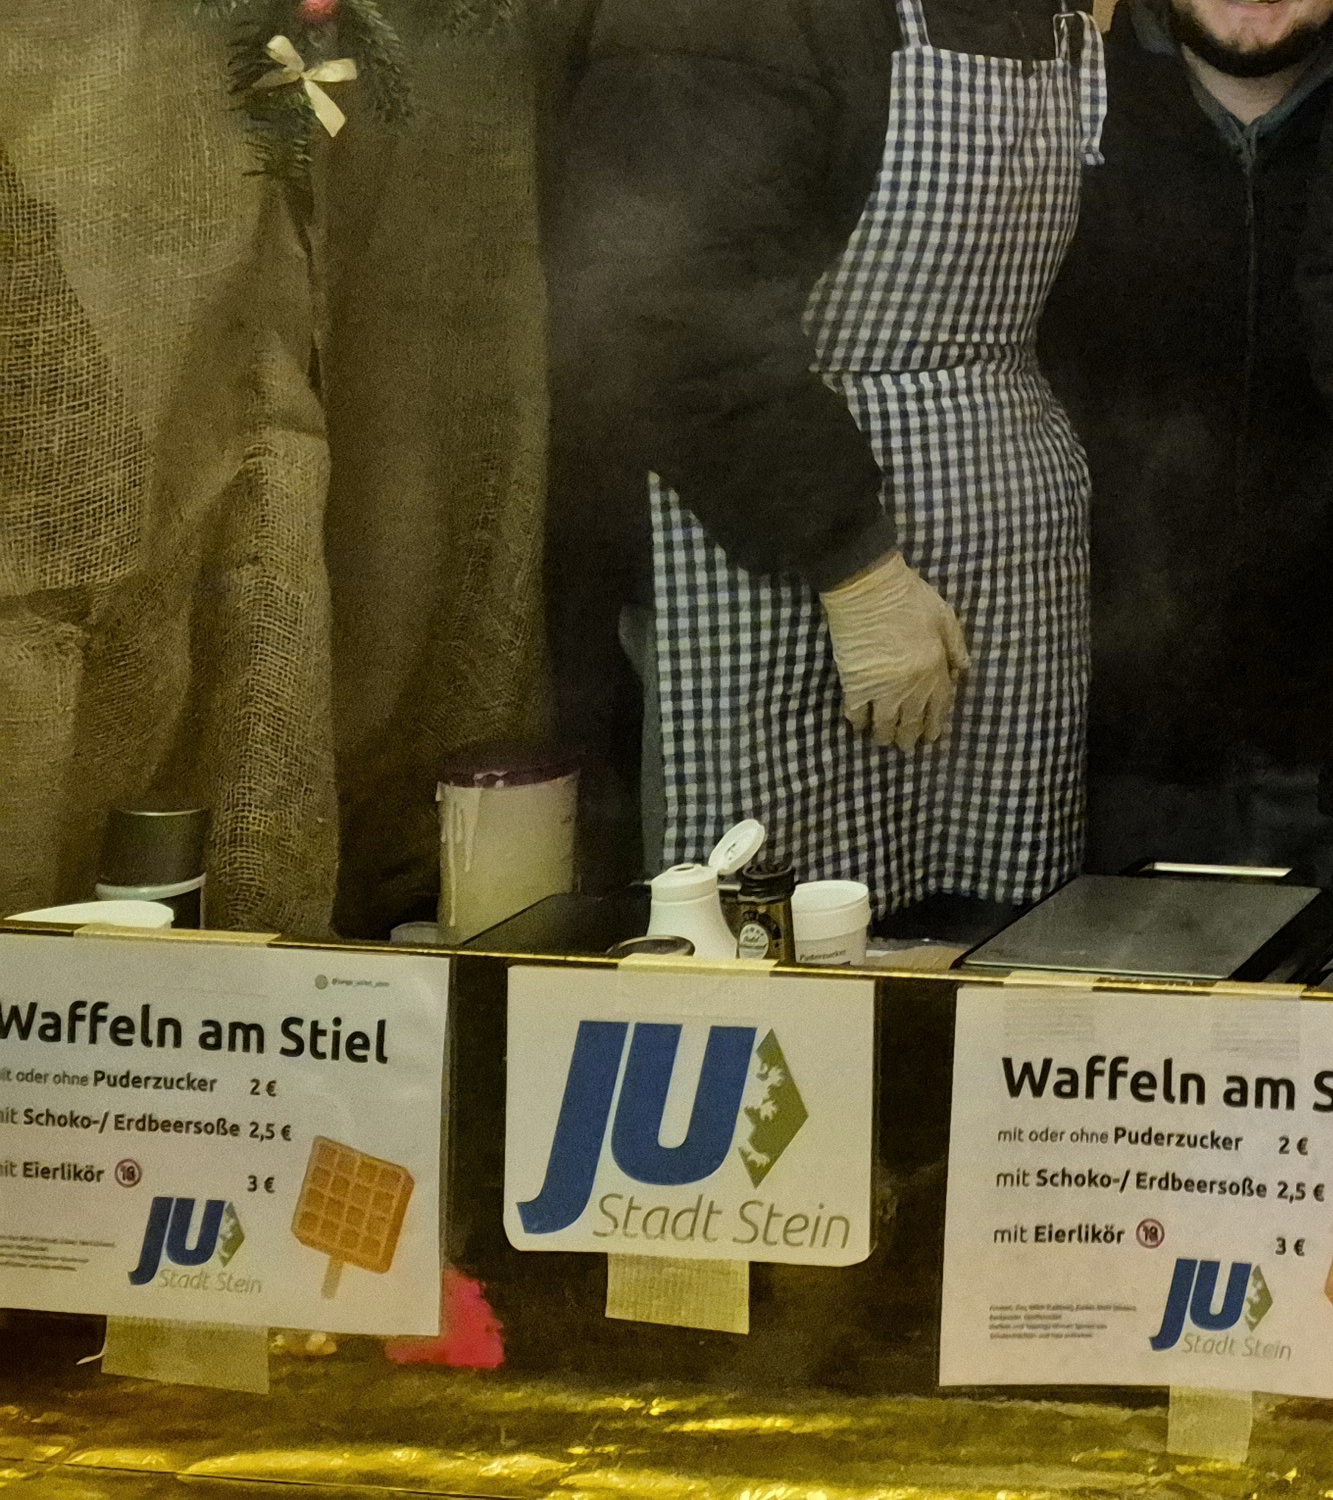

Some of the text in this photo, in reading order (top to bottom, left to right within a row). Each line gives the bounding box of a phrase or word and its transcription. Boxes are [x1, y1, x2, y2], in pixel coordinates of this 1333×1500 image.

[0, 1000, 389, 1065] Waffeln am Stiel
[16, 1068, 49, 1085] oder
[53, 1071, 89, 1087] ohne
[93, 1070, 218, 1094] Puderzucker
[250, 1078, 261, 1095] 2
[265, 1080, 277, 1097] €
[1001, 1055, 1206, 1105] Waffeln
[1222, 1074, 1296, 1111] am
[23, 1108, 109, 1133] Schoko-/
[114, 1114, 241, 1138] Erdbeersoße
[249, 1121, 276, 1142] 2,5
[280, 1124, 292, 1141] €
[516, 1020, 758, 1234] JU
[998, 1127, 1309, 1156] mit oder ohne Puderzucker 2 €
[22, 1161, 105, 1183] Eierlikör
[247, 1175, 258, 1192] 3
[263, 1176, 275, 1193] €
[996, 1168, 1325, 1204] mit Schoko-/ Erdbeersoße 2,5 €
[592, 1193, 851, 1250] Stadt Stein
[127, 1196, 227, 1286] JU
[993, 1225, 1028, 1244] mit
[1034, 1223, 1125, 1245] Eierlikör
[1275, 1237, 1287, 1256] 3
[1292, 1238, 1306, 1257] €
[158, 1269, 262, 1293] Stadt Stein
[1149, 1258, 1252, 1351] JU
[1180, 1332, 1292, 1360] Stadt Stein
